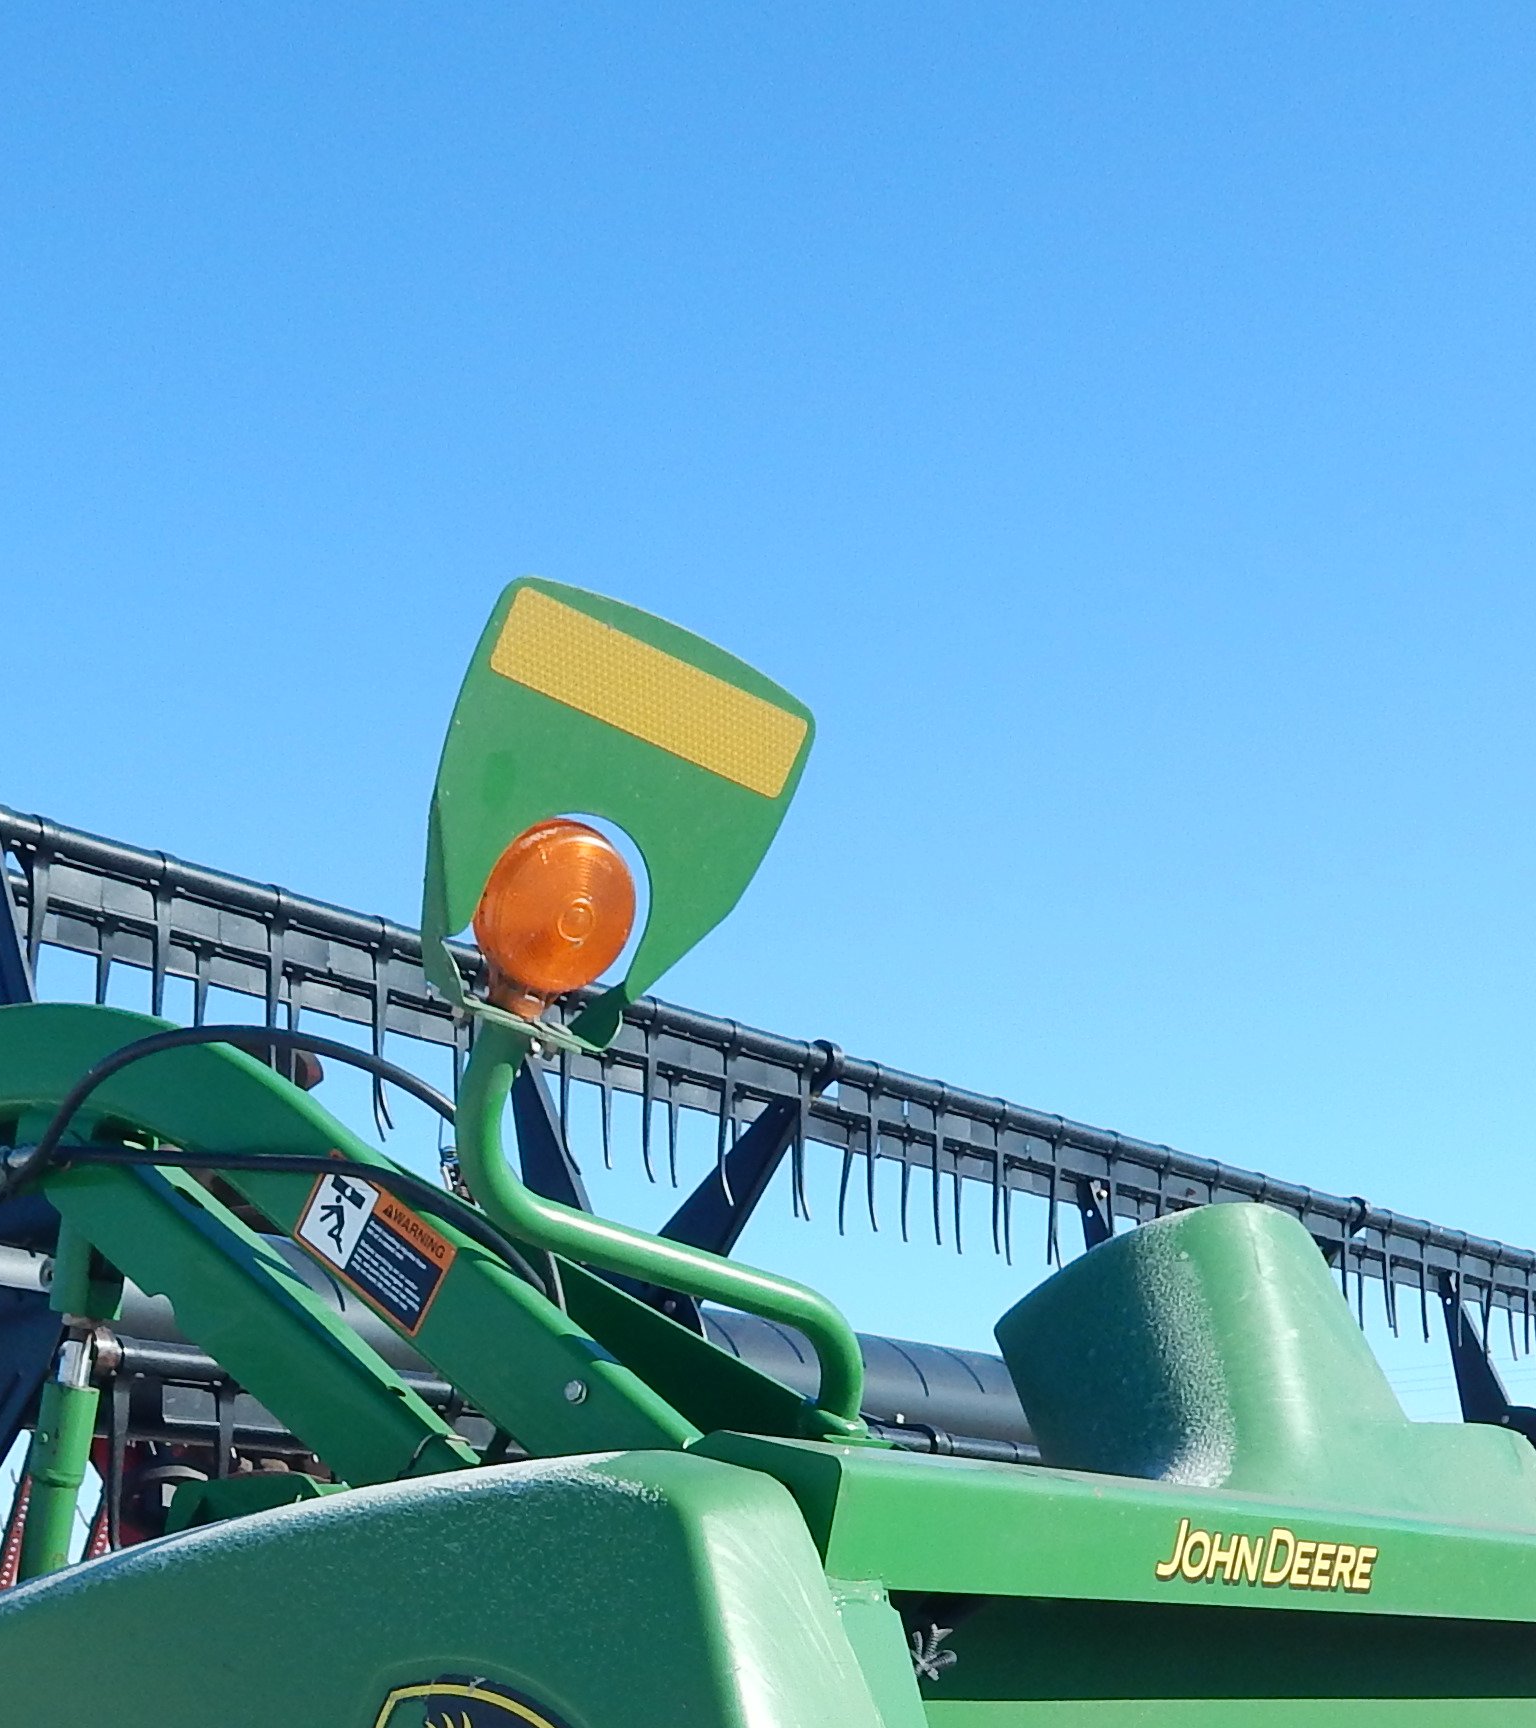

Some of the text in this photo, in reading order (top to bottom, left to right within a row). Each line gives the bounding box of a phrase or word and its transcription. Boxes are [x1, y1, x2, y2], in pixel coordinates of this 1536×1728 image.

[393, 1206, 446, 1259] WARNING
[1155, 1518, 1378, 1593] JOHN DEERE
